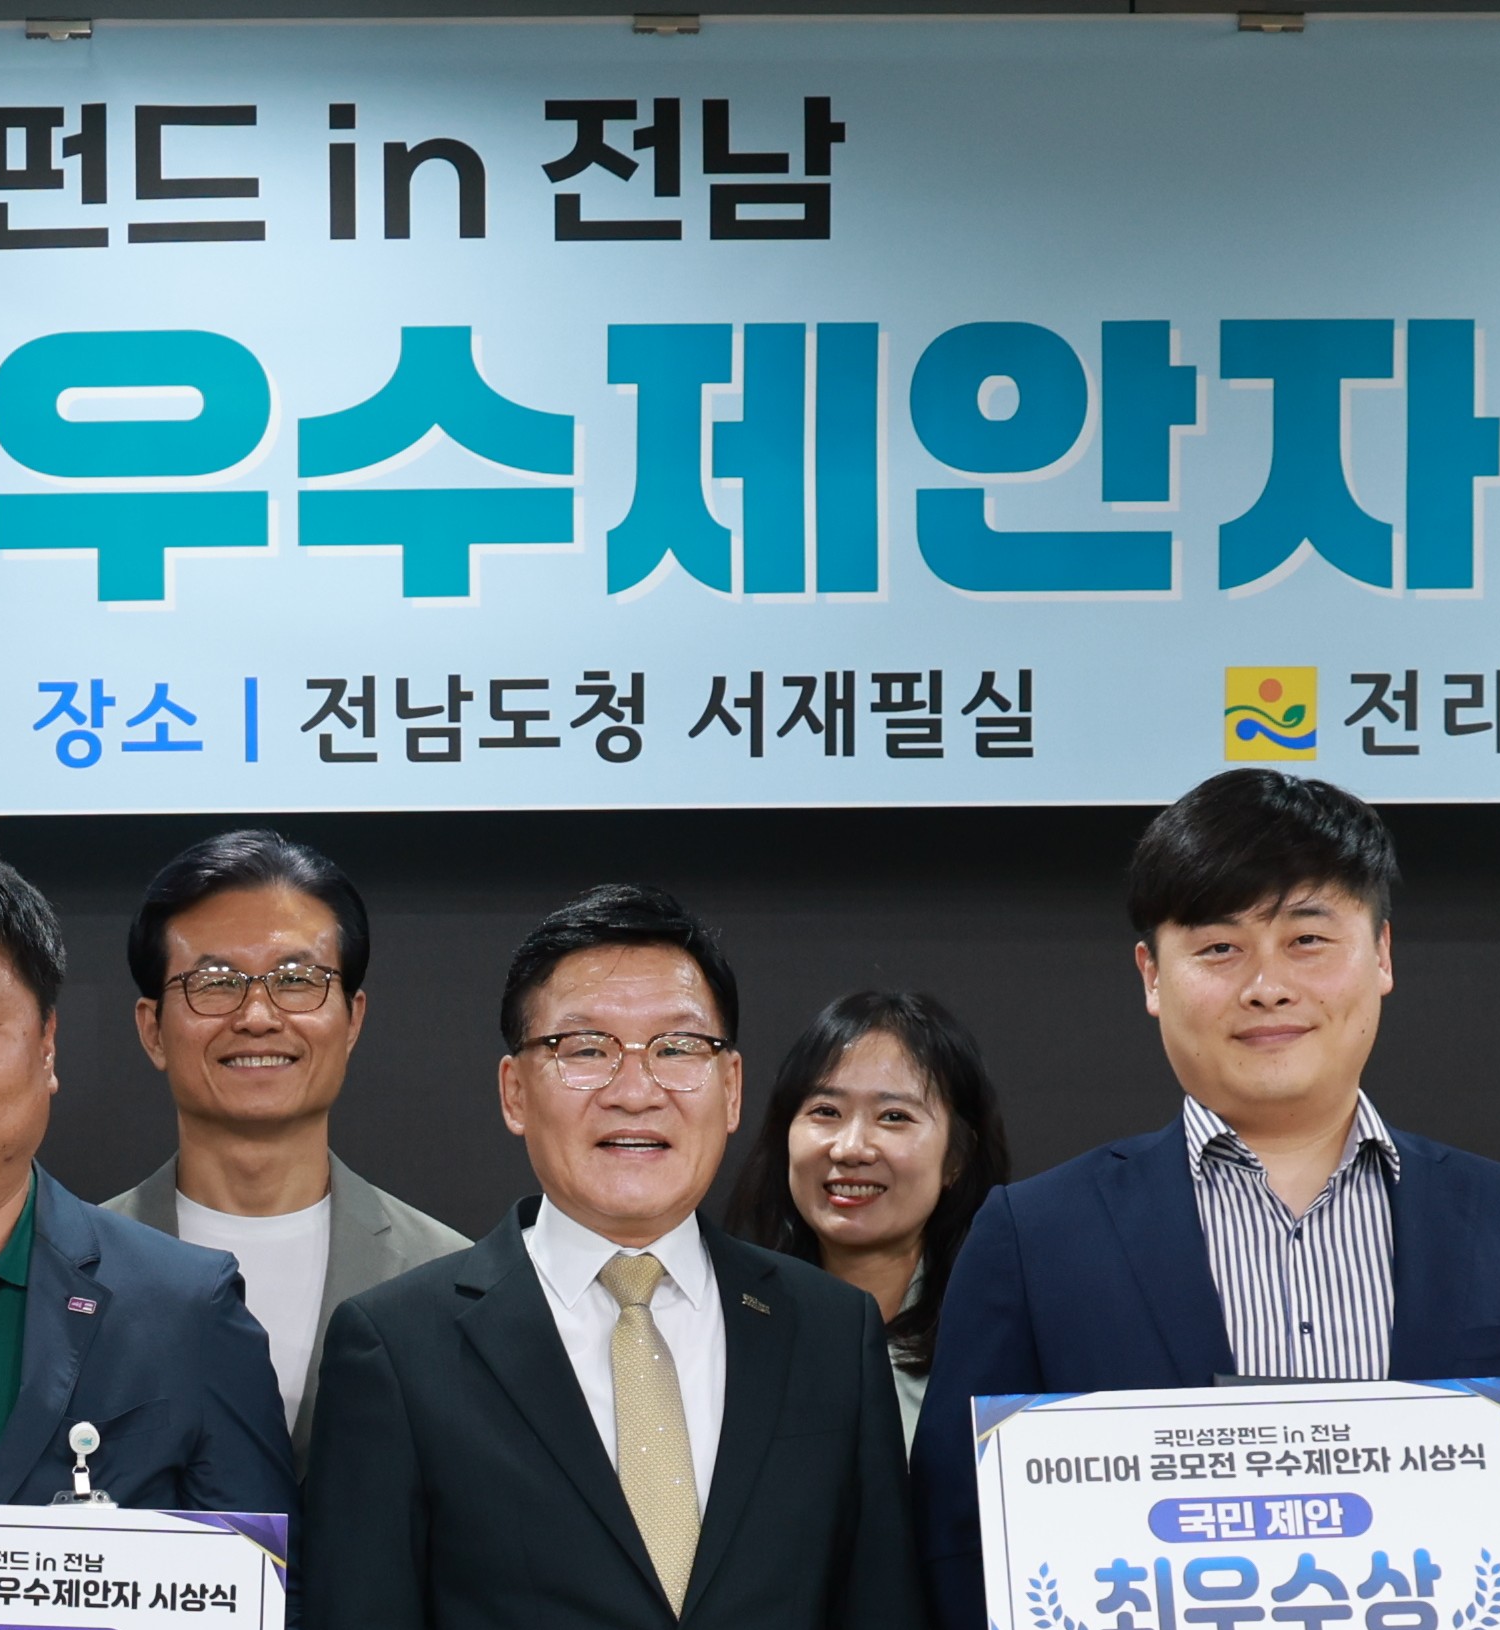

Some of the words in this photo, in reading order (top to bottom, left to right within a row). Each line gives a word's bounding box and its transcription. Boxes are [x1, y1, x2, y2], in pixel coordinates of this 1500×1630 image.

[329, 103, 485, 239] in
[542, 96, 846, 241] 전남
[33, 679, 203, 768] 장소
[301, 671, 644, 763] 전남도청
[688, 669, 1033, 758] 서재필실
[1155, 1427, 1277, 1447] 국민성장펀드
[1283, 1426, 1304, 1443] in
[1311, 1424, 1350, 1442] 전남
[1026, 1455, 1140, 1484] 아이디어
[1151, 1452, 1236, 1480] 공모전
[1246, 1447, 1390, 1477] 우수제안자
[1400, 1443, 1485, 1471] 시상식
[1179, 1502, 1255, 1538] 국민
[1265, 1499, 1343, 1536] 제안
[36, 1552, 56, 1571] in
[64, 1554, 104, 1573] 전남
[149, 1583, 236, 1613] 시상식
